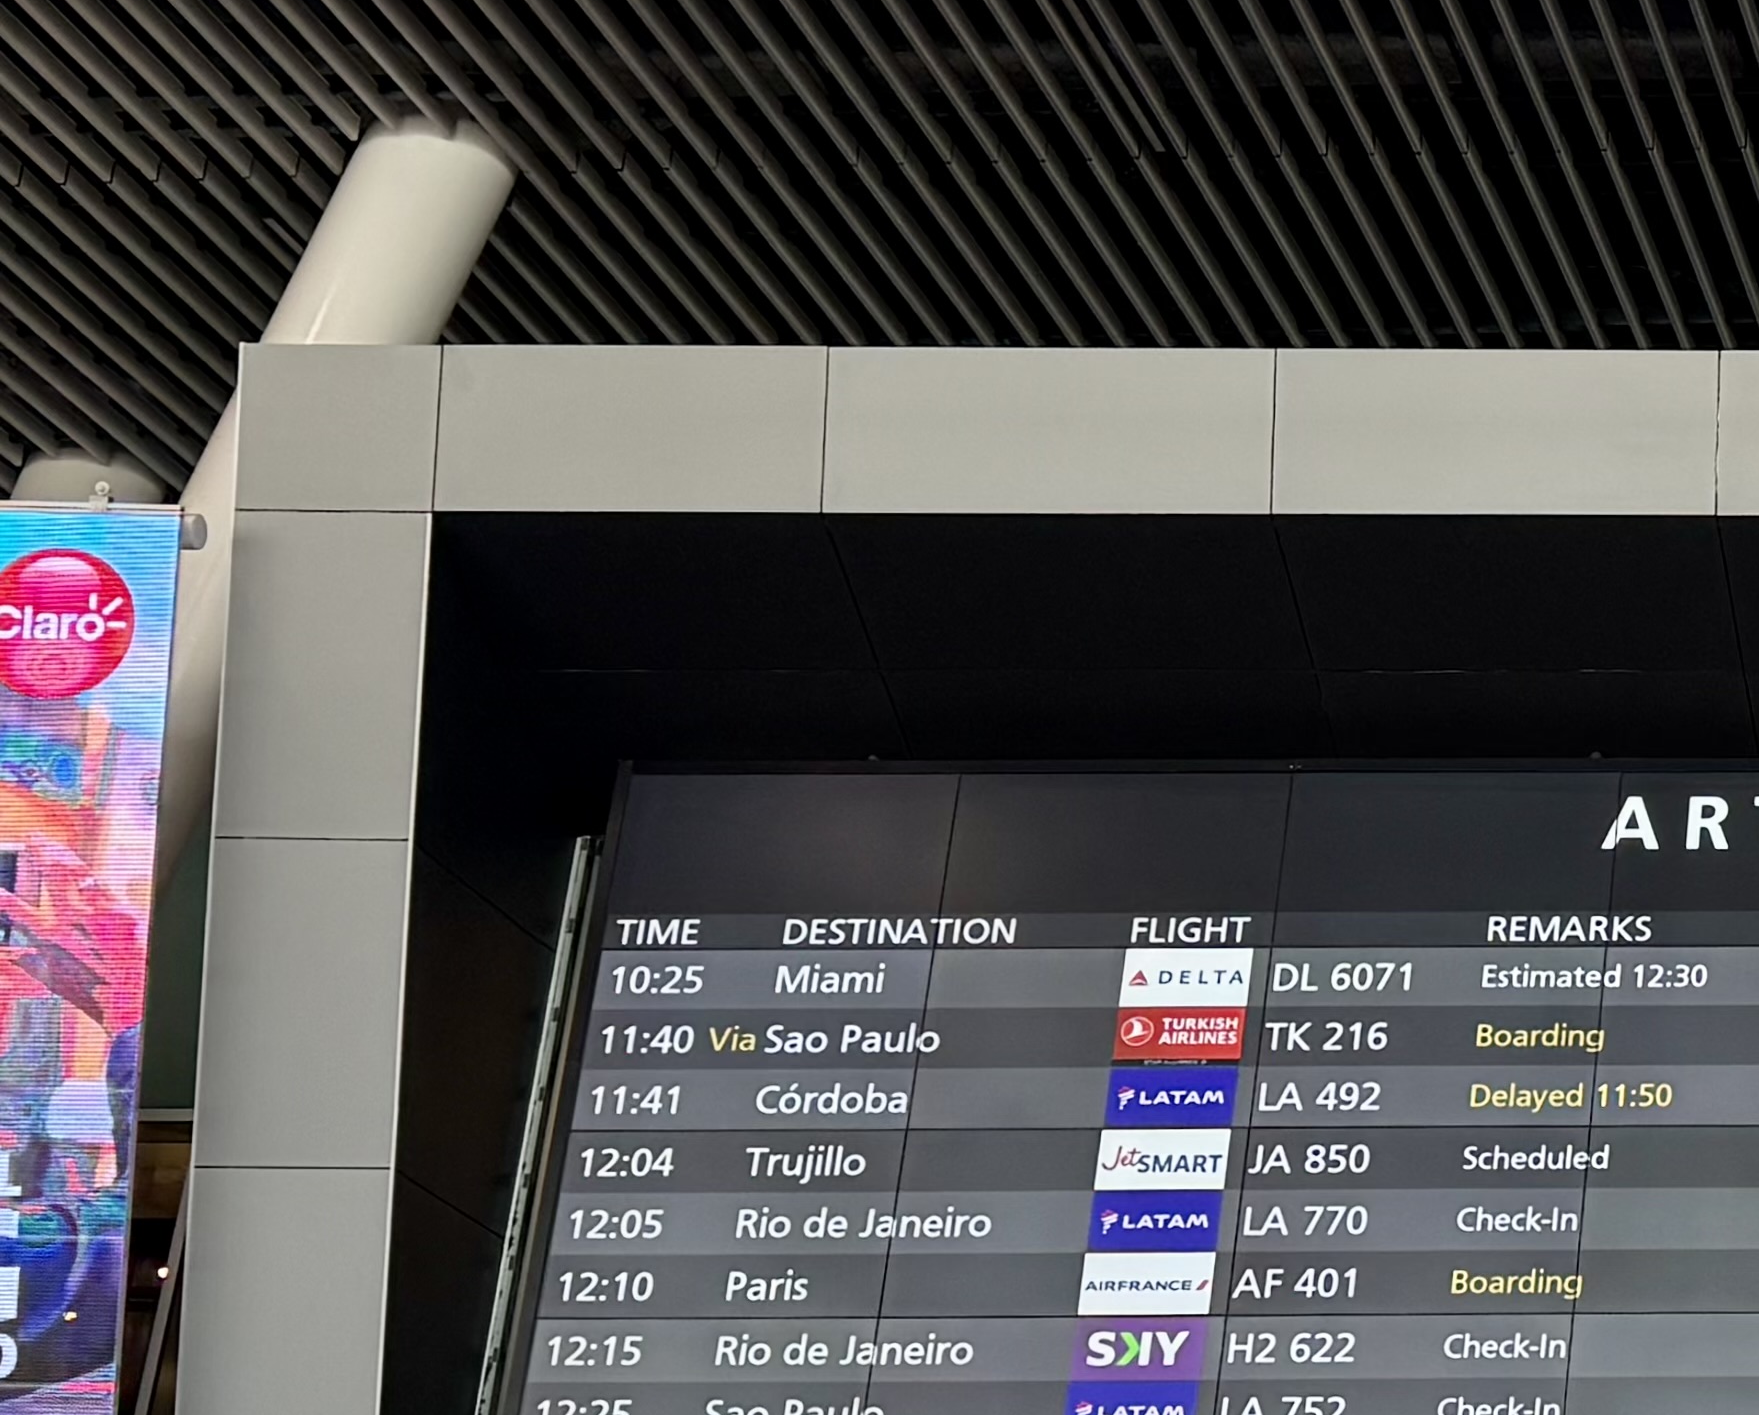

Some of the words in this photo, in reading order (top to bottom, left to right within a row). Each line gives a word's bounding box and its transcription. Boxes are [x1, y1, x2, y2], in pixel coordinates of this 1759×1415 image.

[617, 919, 700, 945] TIME
[783, 918, 1016, 944] DESTINATION
[1131, 917, 1251, 943] FLIGHT
[1488, 916, 1651, 941] REMARKS
[613, 966, 704, 994] 10:25
[775, 963, 885, 993] Miami
[1159, 970, 1243, 984] DELTA
[1273, 963, 1318, 991] DL
[1331, 963, 1411, 990] 6071
[1482, 963, 1621, 987] Estimated
[1634, 965, 1707, 988] 12:30
[592, 1086, 680, 1114] 11:41
[756, 1083, 907, 1114] Córdoba
